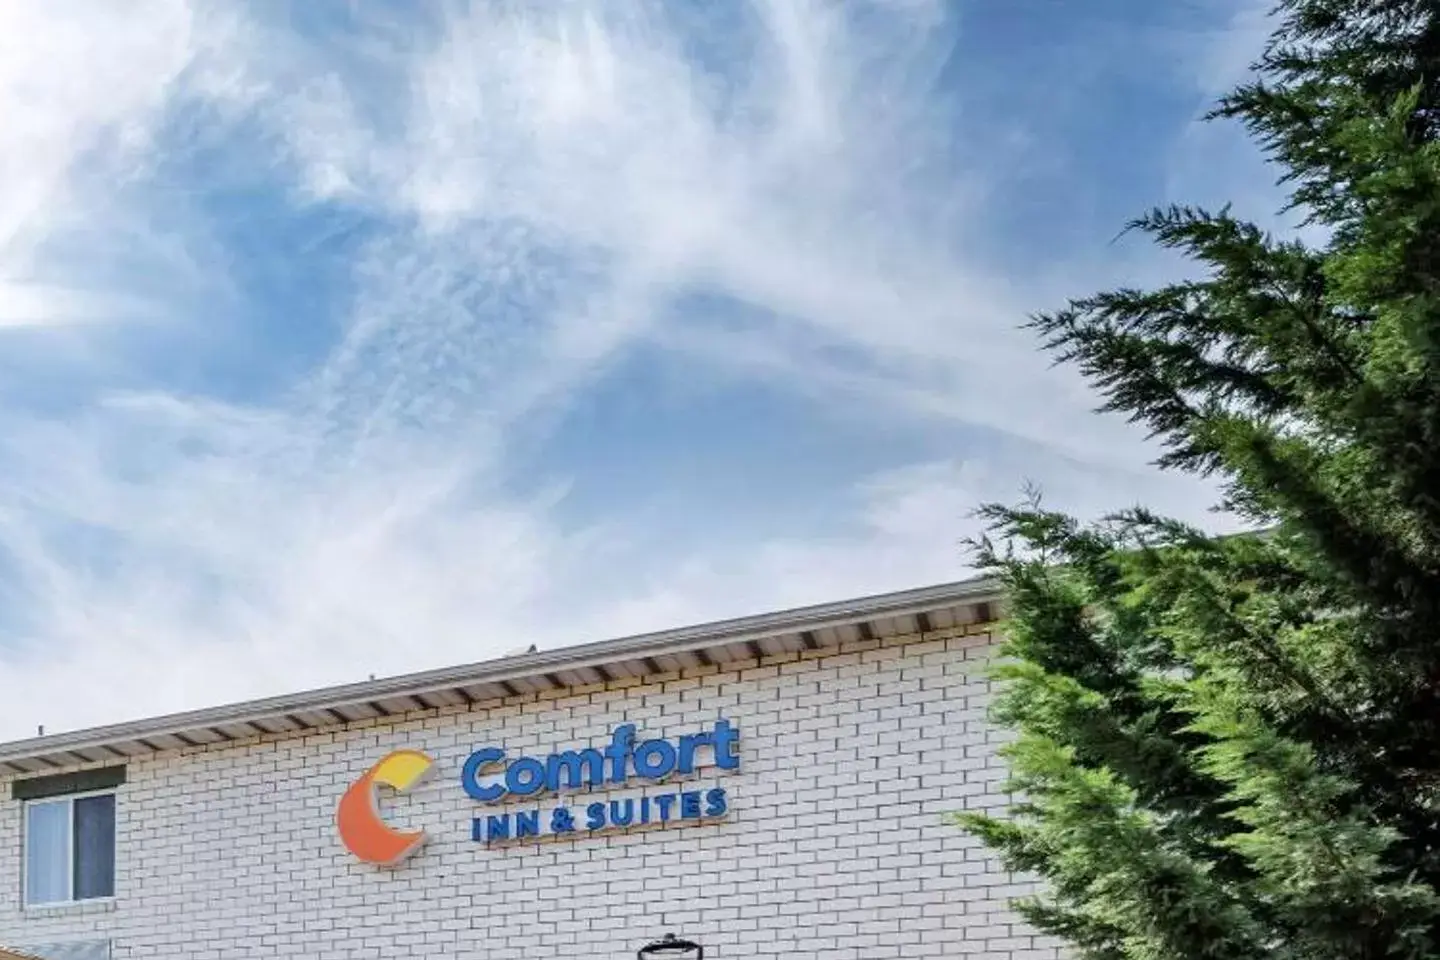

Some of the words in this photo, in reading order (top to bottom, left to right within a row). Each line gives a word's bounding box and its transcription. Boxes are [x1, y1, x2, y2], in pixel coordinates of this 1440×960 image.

[462, 719, 740, 801] Comfort
[471, 809, 540, 842] INN
[550, 806, 576, 833] &
[586, 787, 727, 830] SUITES
